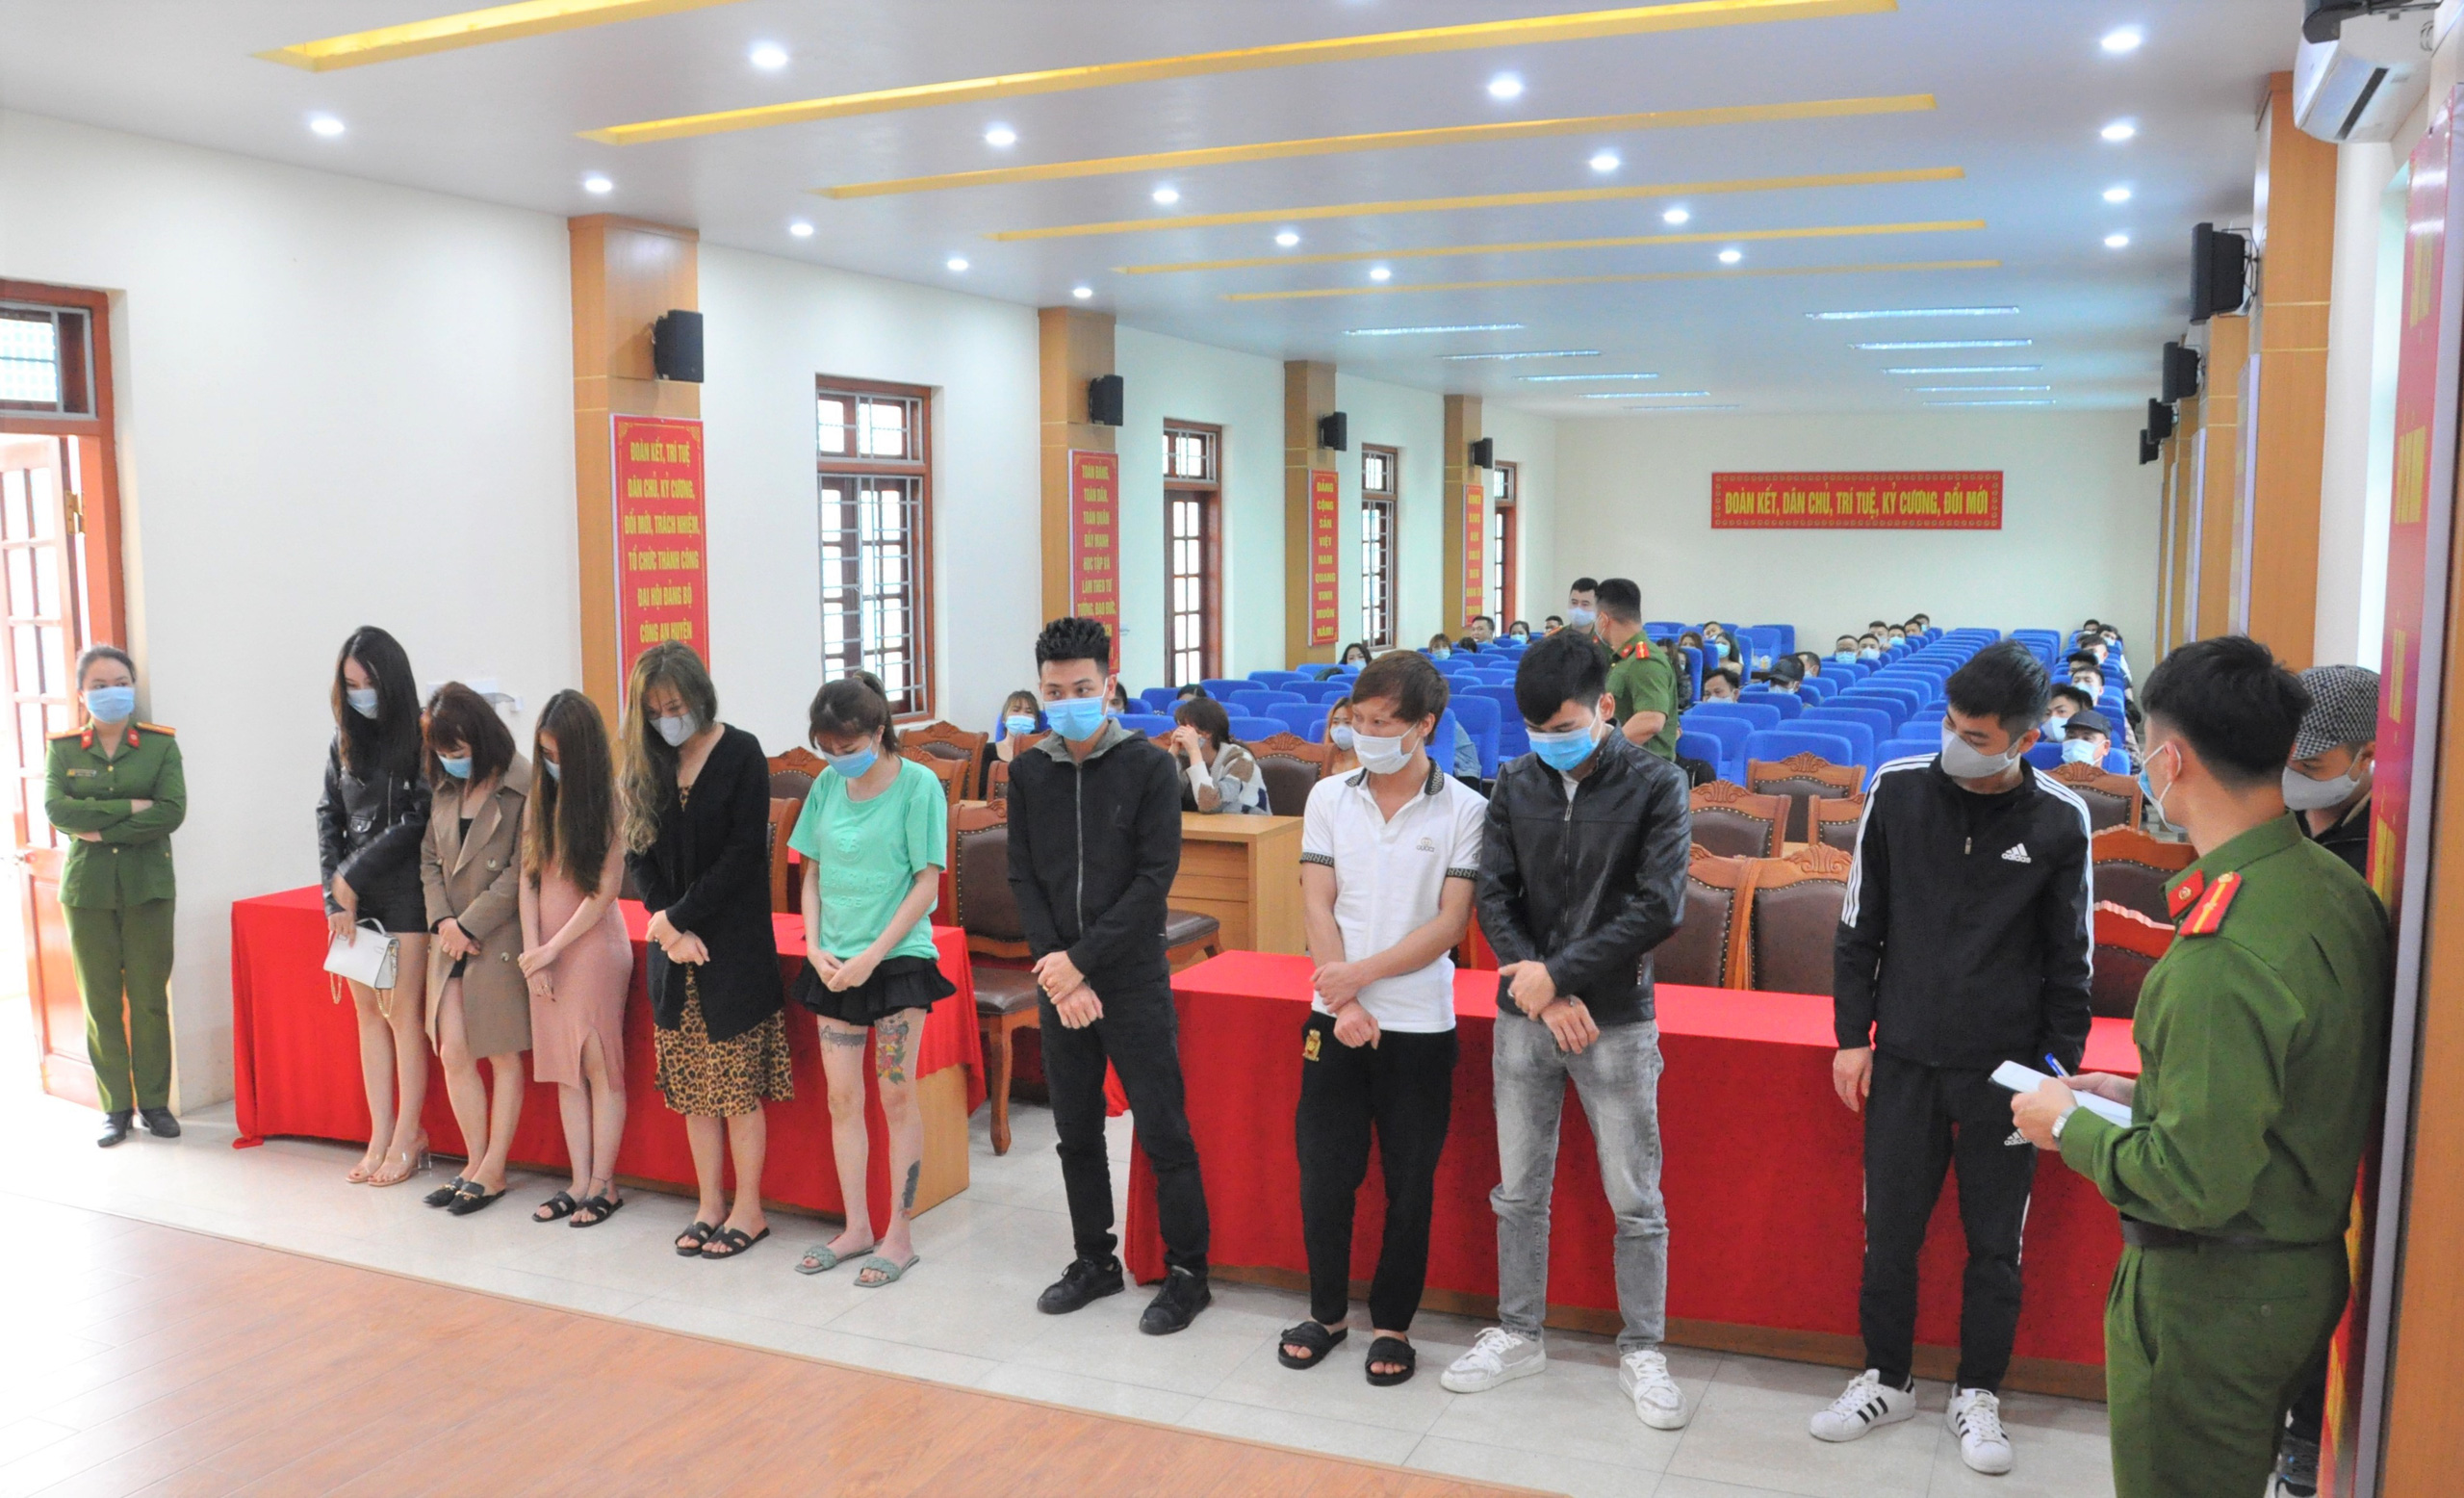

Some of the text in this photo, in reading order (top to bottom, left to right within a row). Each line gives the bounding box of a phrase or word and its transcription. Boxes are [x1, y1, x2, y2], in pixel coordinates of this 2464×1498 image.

[630, 437, 690, 467] ĐOÀN KẾT, TRÍ TUỆ
[628, 471, 695, 500] DÂN CHỦ, KỶ CƯƠNG,
[1725, 481, 1988, 520] ĐOÀN KẾT, DÂN CHỦ, TRÍ TUỆ, KỶ CƯƠNG, ĐỔI MỚI
[624, 508, 700, 537] ĐỔI MỚI, TRÁCH NHIỆM,
[628, 544, 699, 570] TỔ CHỨC THÀNH CÔNG
[637, 579, 692, 610] ĐẠI HỘI ĐẢNG BỘ
[640, 618, 692, 643] CÔNG AN HUYỆN
[2001, 853, 2032, 864] adidas
